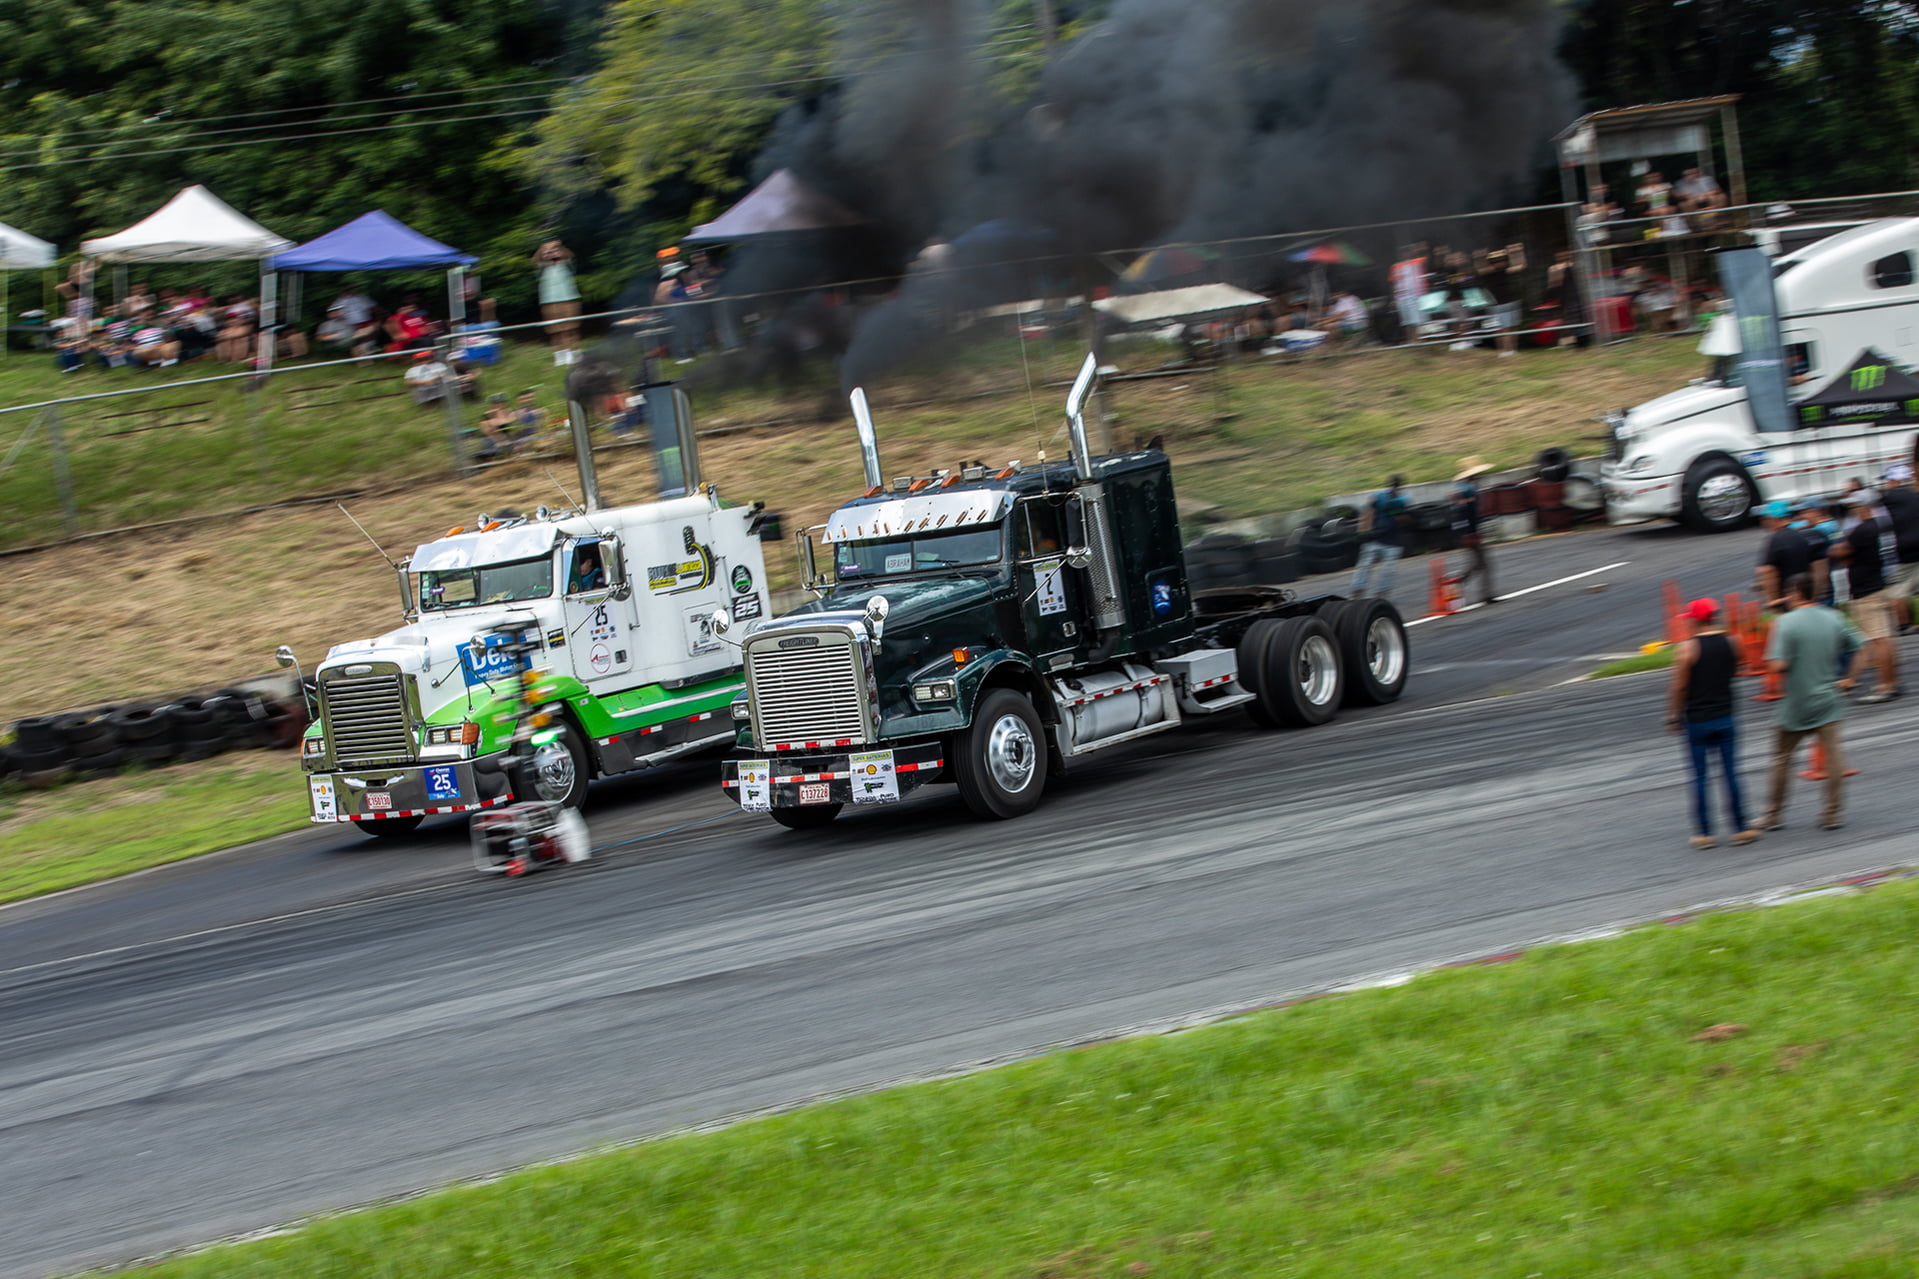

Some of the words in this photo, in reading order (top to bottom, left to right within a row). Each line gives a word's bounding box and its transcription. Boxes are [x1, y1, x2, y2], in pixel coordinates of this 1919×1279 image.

[594, 604, 608, 626] 25
[735, 600, 759, 618] 25
[432, 773, 452, 791] 25
[801, 787, 828, 800] C137228
